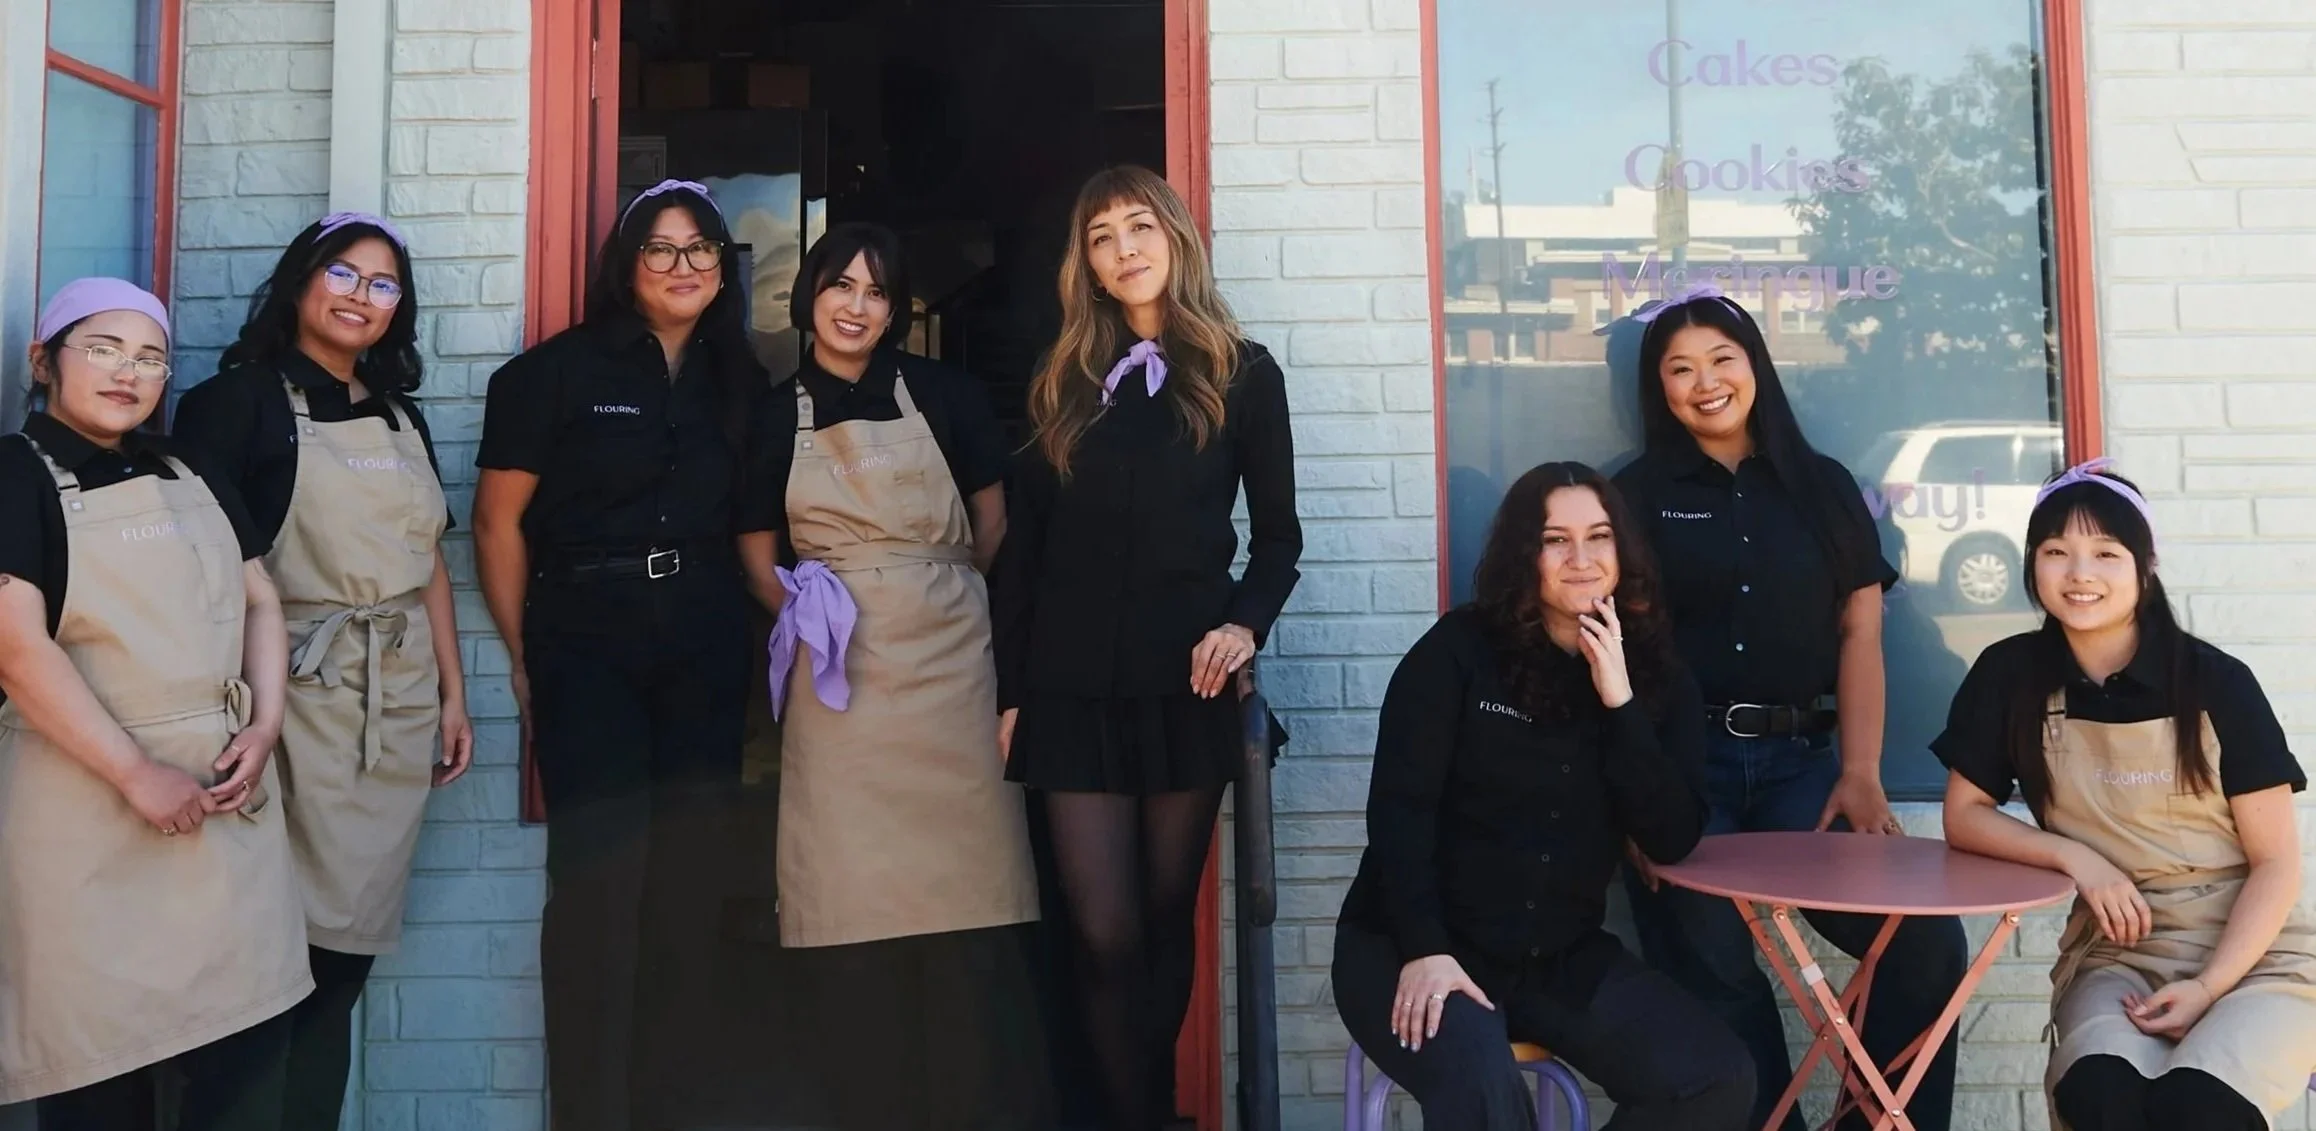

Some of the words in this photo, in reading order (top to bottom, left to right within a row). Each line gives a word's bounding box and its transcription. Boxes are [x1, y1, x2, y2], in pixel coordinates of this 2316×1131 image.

[1647, 38, 1839, 89] Cakes
[1624, 143, 1872, 193] Cookies
[1602, 251, 1900, 313] Meringue
[593, 405, 641, 415] FLOURING
[120, 520, 186, 543] FLOUR
[1661, 510, 1713, 520] FLOURING
